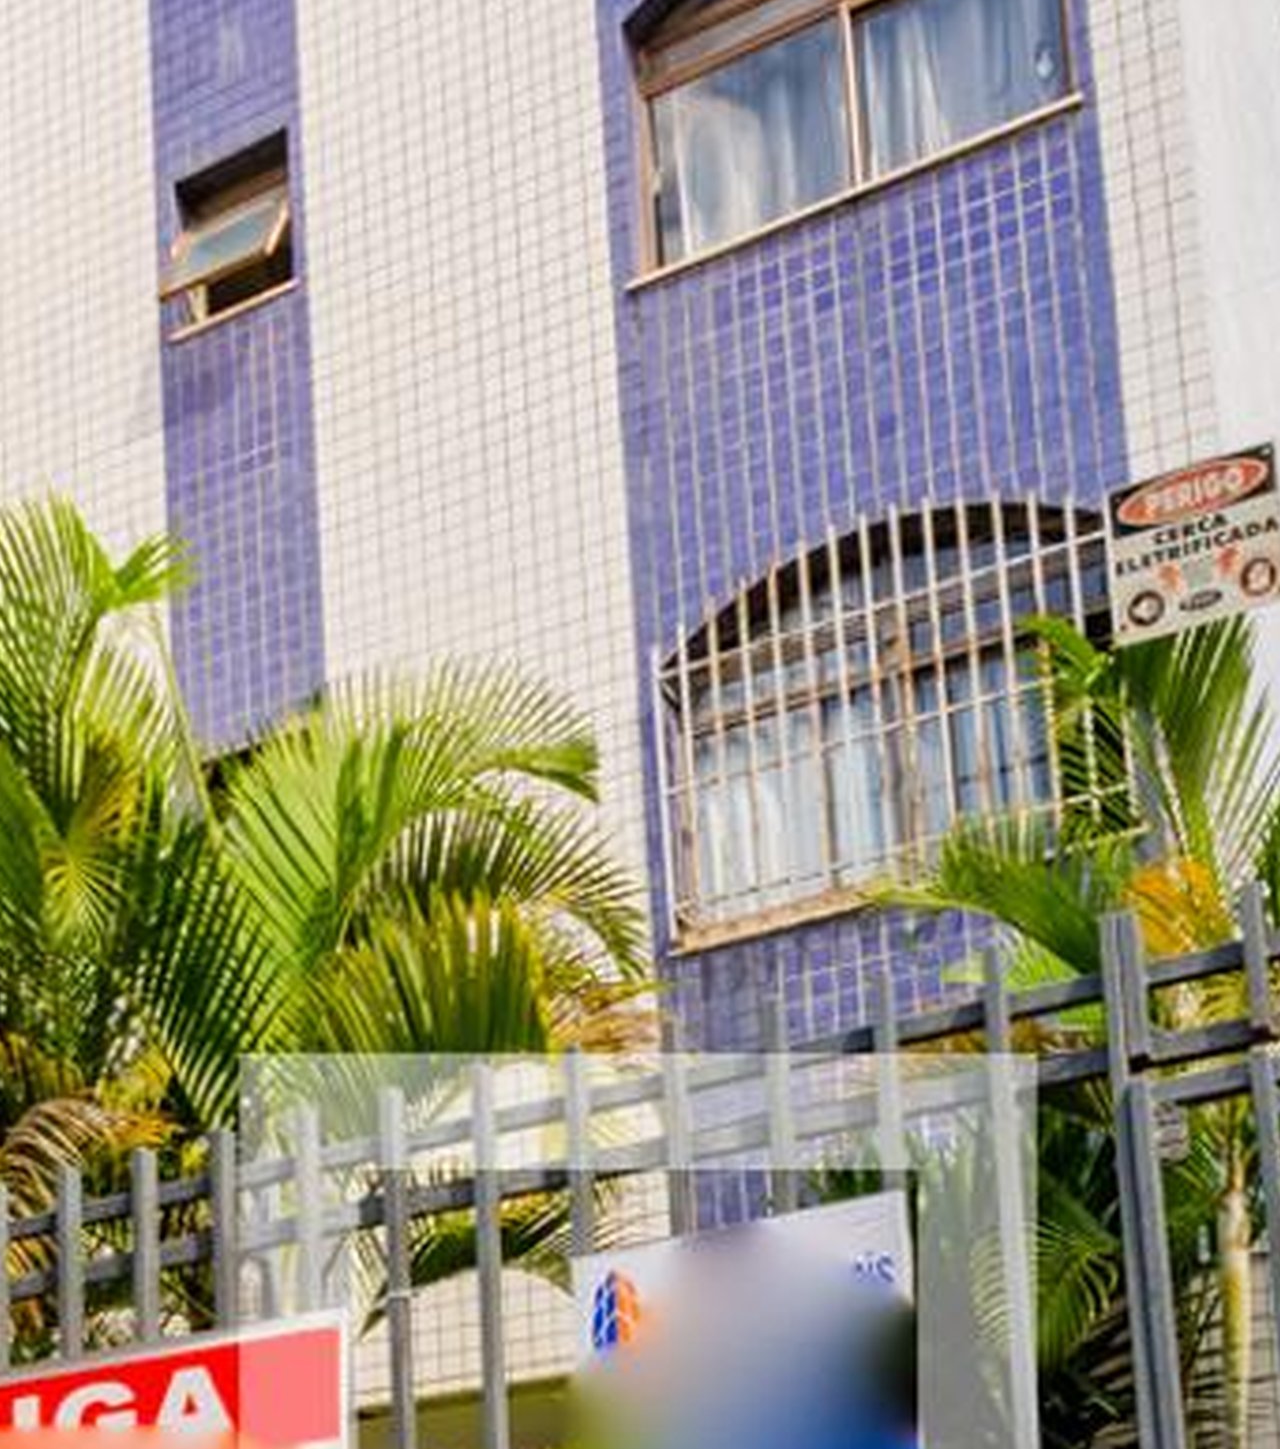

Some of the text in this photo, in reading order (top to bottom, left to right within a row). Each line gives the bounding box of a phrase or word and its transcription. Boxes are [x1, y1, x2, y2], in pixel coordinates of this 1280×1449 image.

[1143, 466, 1244, 519] PERIGO
[1114, 518, 1280, 576] ELETRIFICADA
[1153, 514, 1228, 545] CERCA
